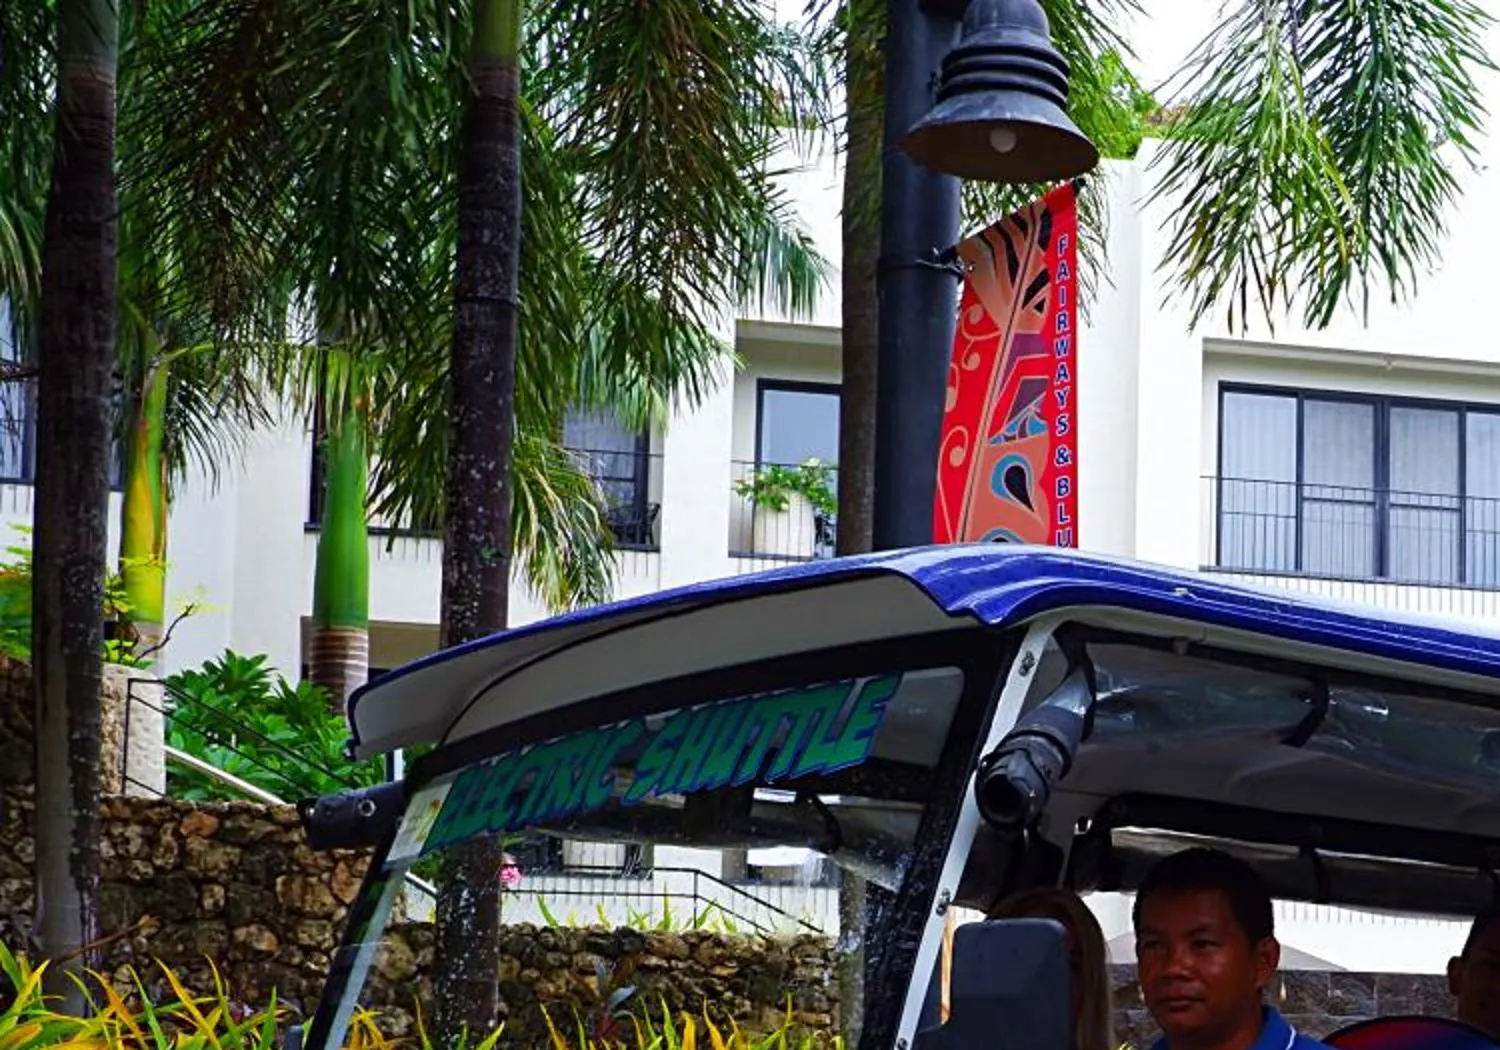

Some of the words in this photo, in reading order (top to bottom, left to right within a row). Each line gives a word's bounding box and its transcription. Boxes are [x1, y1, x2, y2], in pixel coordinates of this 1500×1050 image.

[1055, 234, 1069, 434] FAIRWAYS
[1055, 448, 1070, 465] &
[419, 721, 643, 856] ELECTRIC
[621, 672, 900, 803] SHUTTLE
